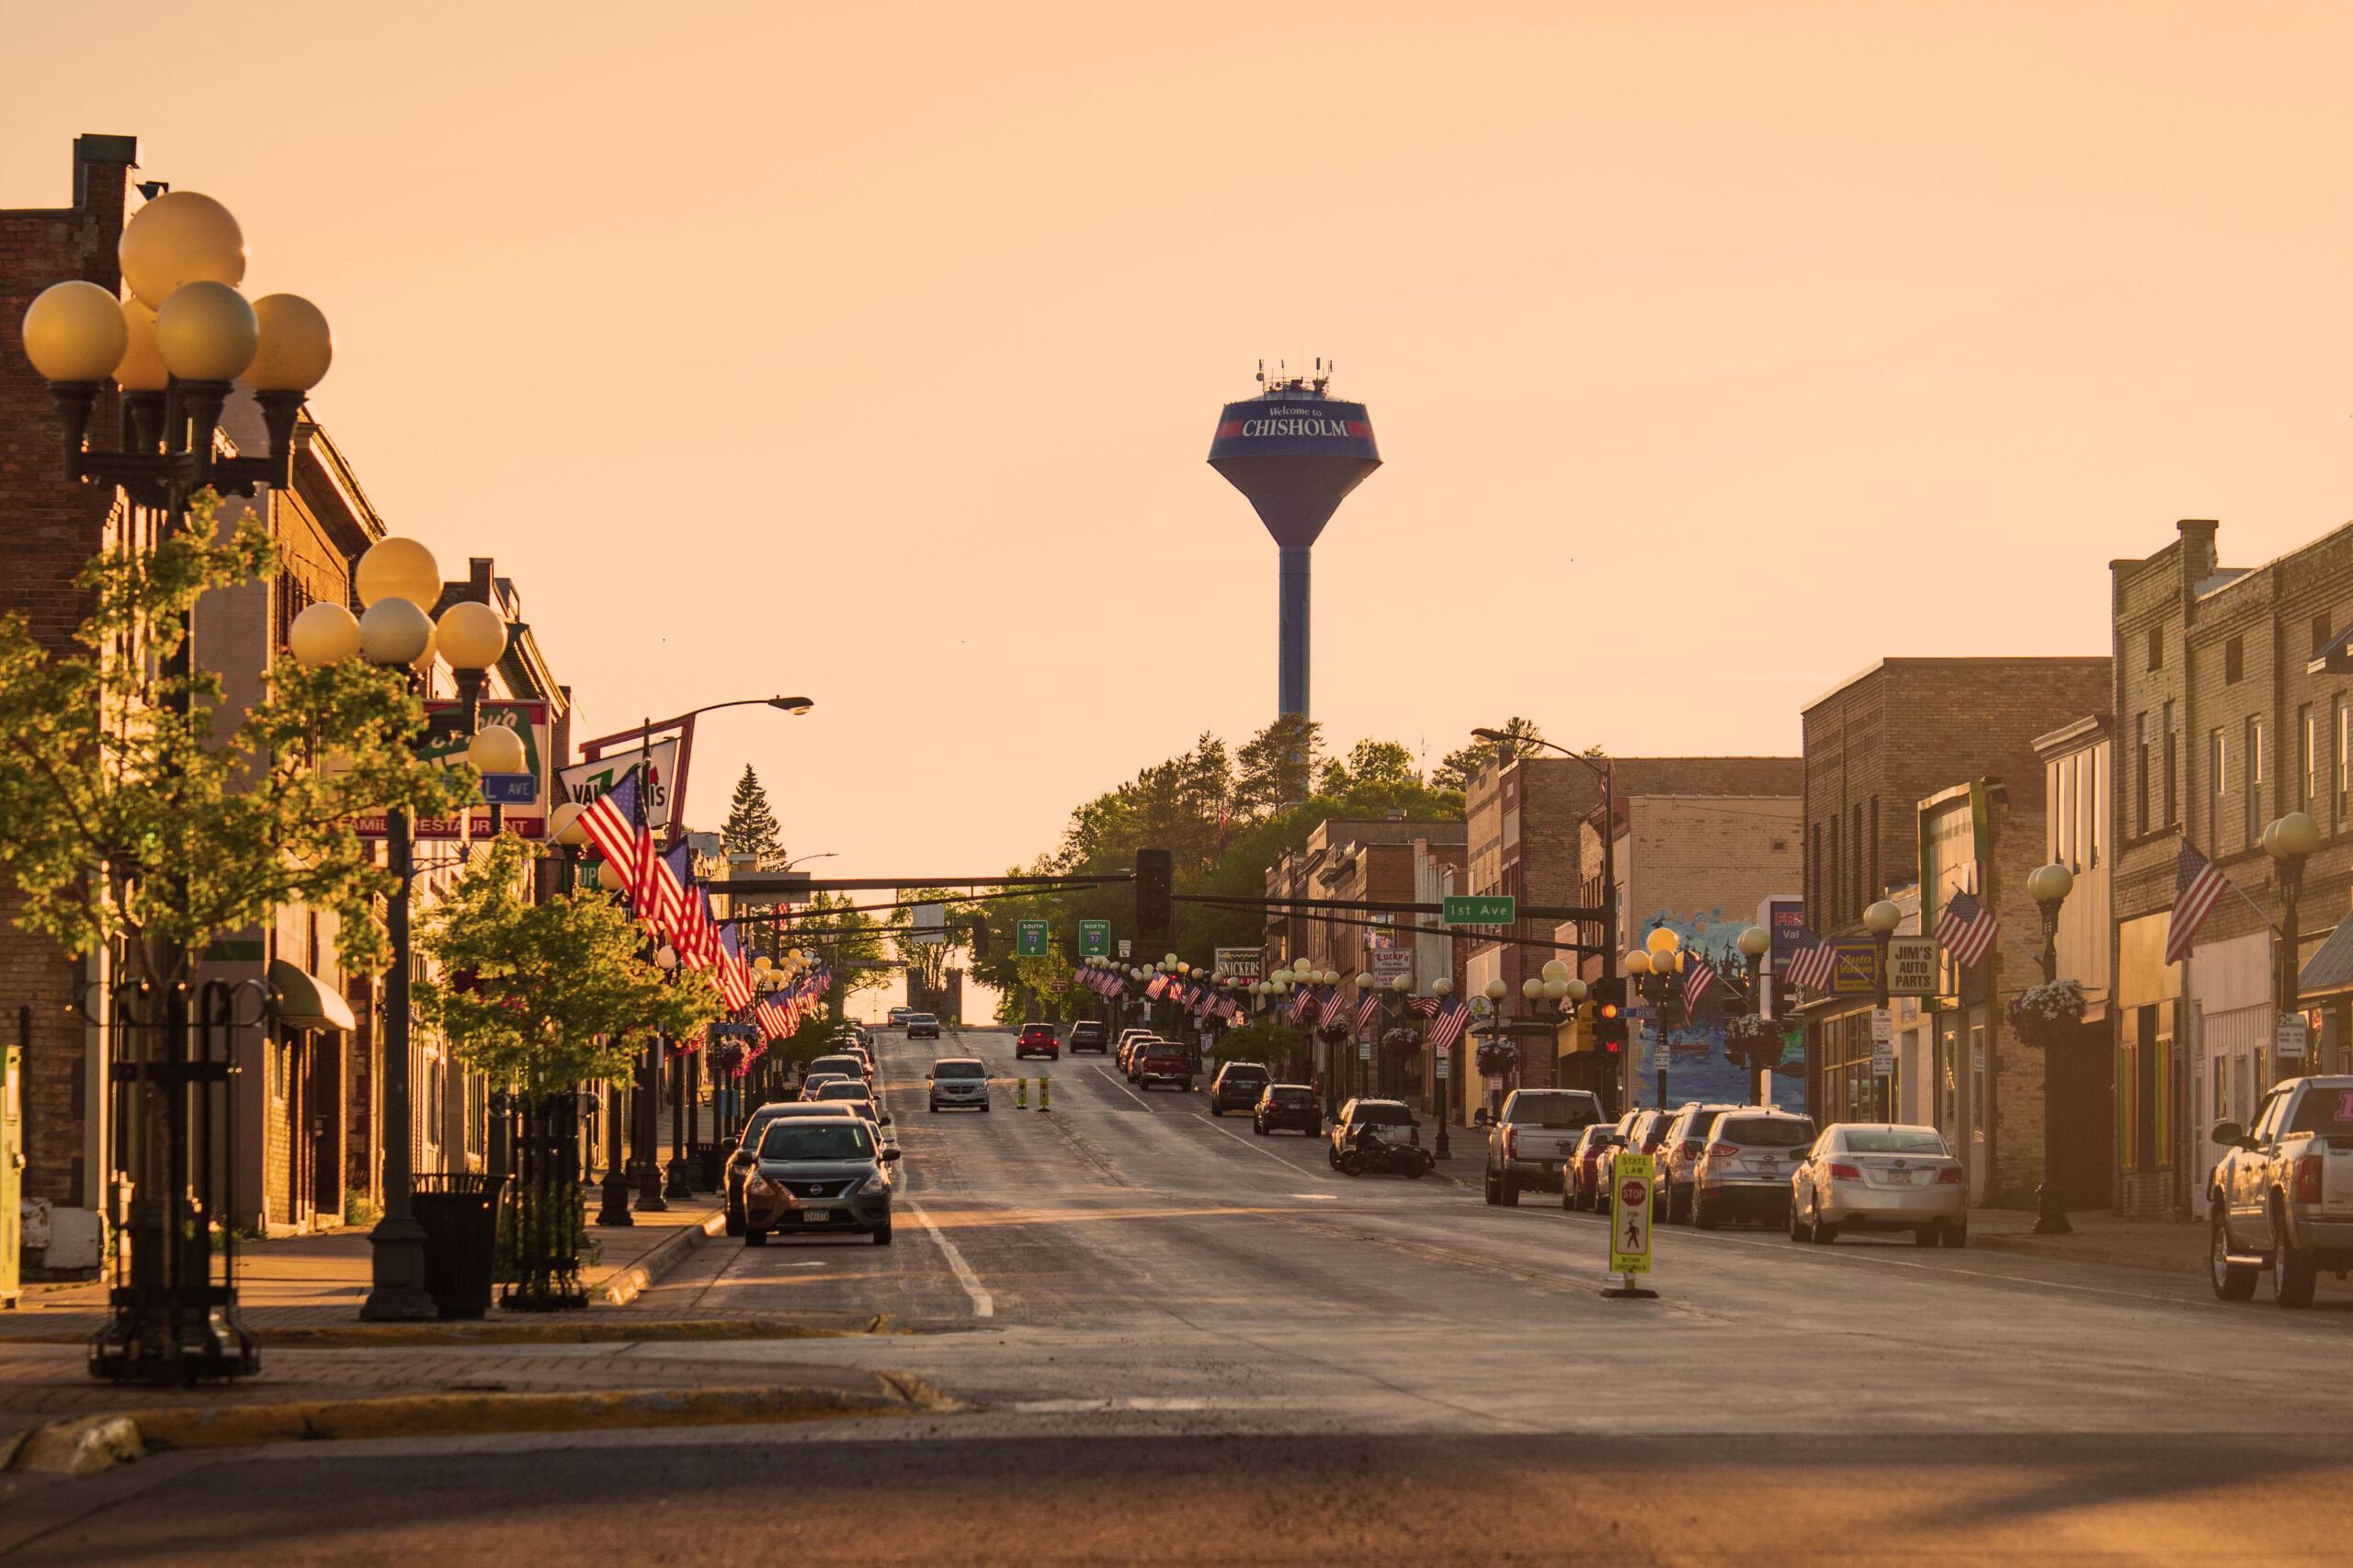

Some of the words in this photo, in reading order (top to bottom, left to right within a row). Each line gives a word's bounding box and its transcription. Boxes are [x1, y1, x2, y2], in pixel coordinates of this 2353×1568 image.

[1269, 405, 1310, 417] Welcome
[1313, 408, 1323, 417] to
[1242, 418, 1349, 437] CHISHOLM
[507, 782, 530, 796] AVE
[1450, 904, 1471, 915] 1st
[1480, 904, 1506, 915] Ave
[1375, 951, 1409, 962] Lucky's
[1841, 954, 1872, 964] Auto
[1894, 946, 1932, 960] JIM'S
[1219, 961, 1259, 976] SNICKERS
[1839, 964, 1874, 973] Value
[1899, 961, 1927, 973] AUTO
[1895, 975, 1930, 987] PARTS
[1622, 1157, 1648, 1165] STATE
[1622, 1188, 1645, 1199] STOP
